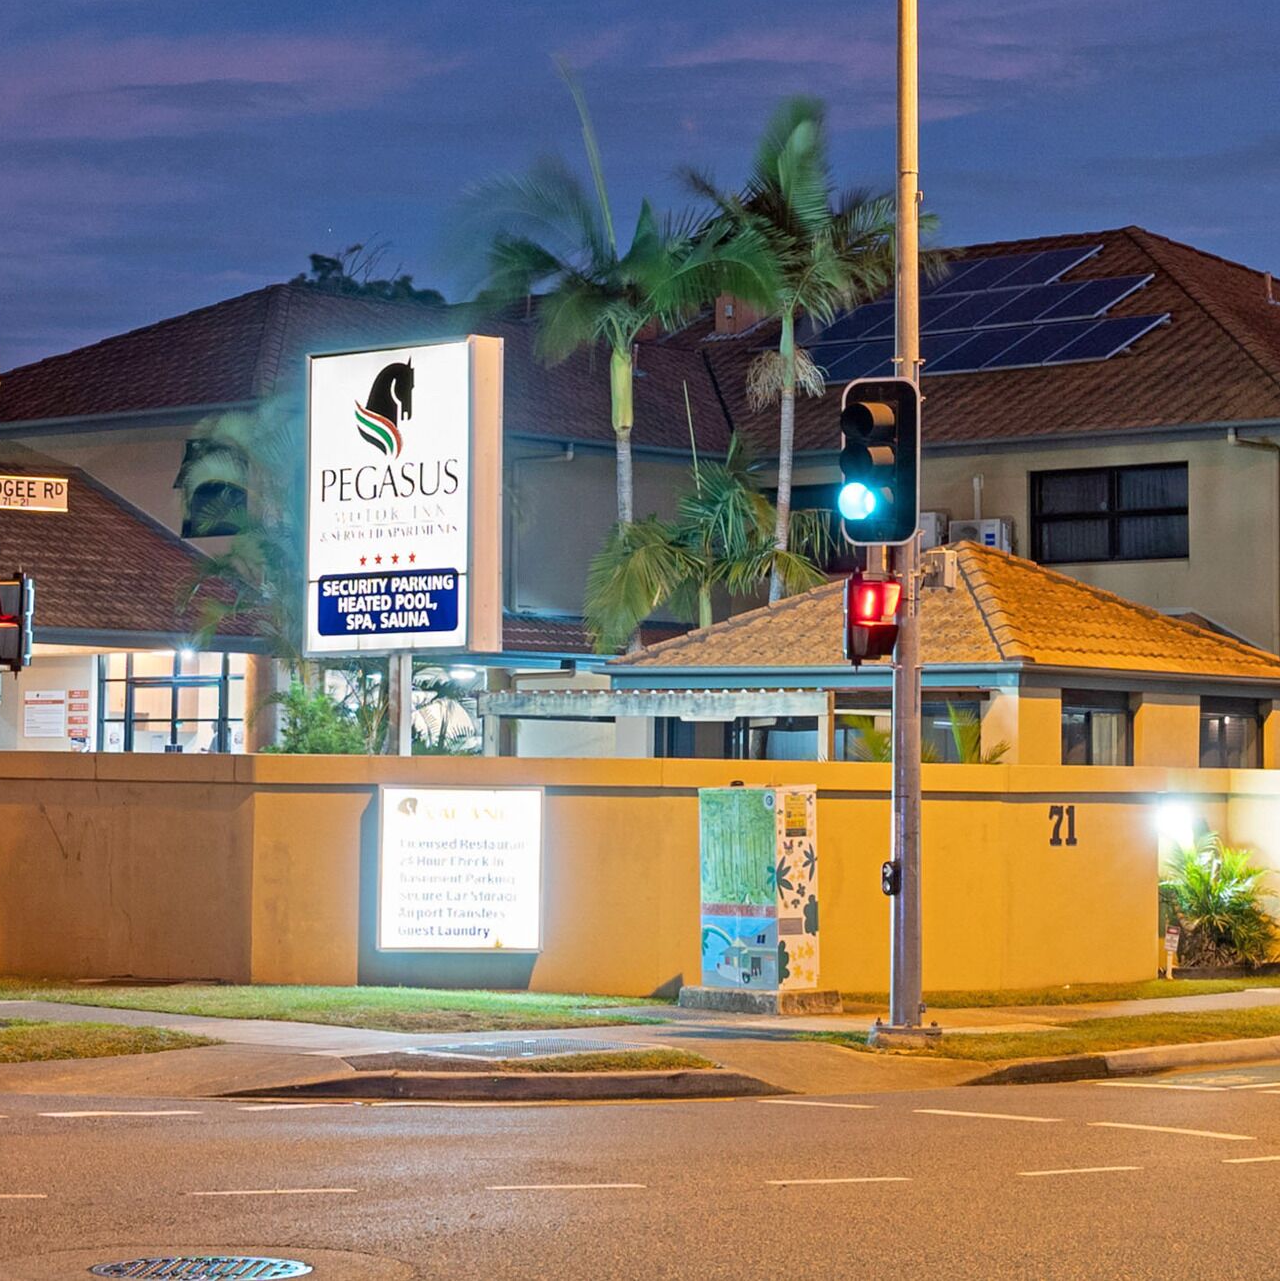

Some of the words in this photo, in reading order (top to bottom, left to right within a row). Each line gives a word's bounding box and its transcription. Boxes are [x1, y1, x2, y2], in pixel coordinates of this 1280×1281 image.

[44, 482, 64, 499] RD
[321, 459, 459, 502] PEGASUS
[322, 577, 388, 597] SECURITY
[390, 575, 454, 593] PARKING
[337, 594, 392, 613] HEATED
[395, 592, 438, 611] POOL,
[346, 613, 377, 631] SPA,
[380, 611, 430, 629] SAUNA
[1049, 805, 1078, 846] 71
[416, 856, 447, 867] Hour
[397, 925, 434, 937] Guest
[437, 925, 491, 939] Laundry
